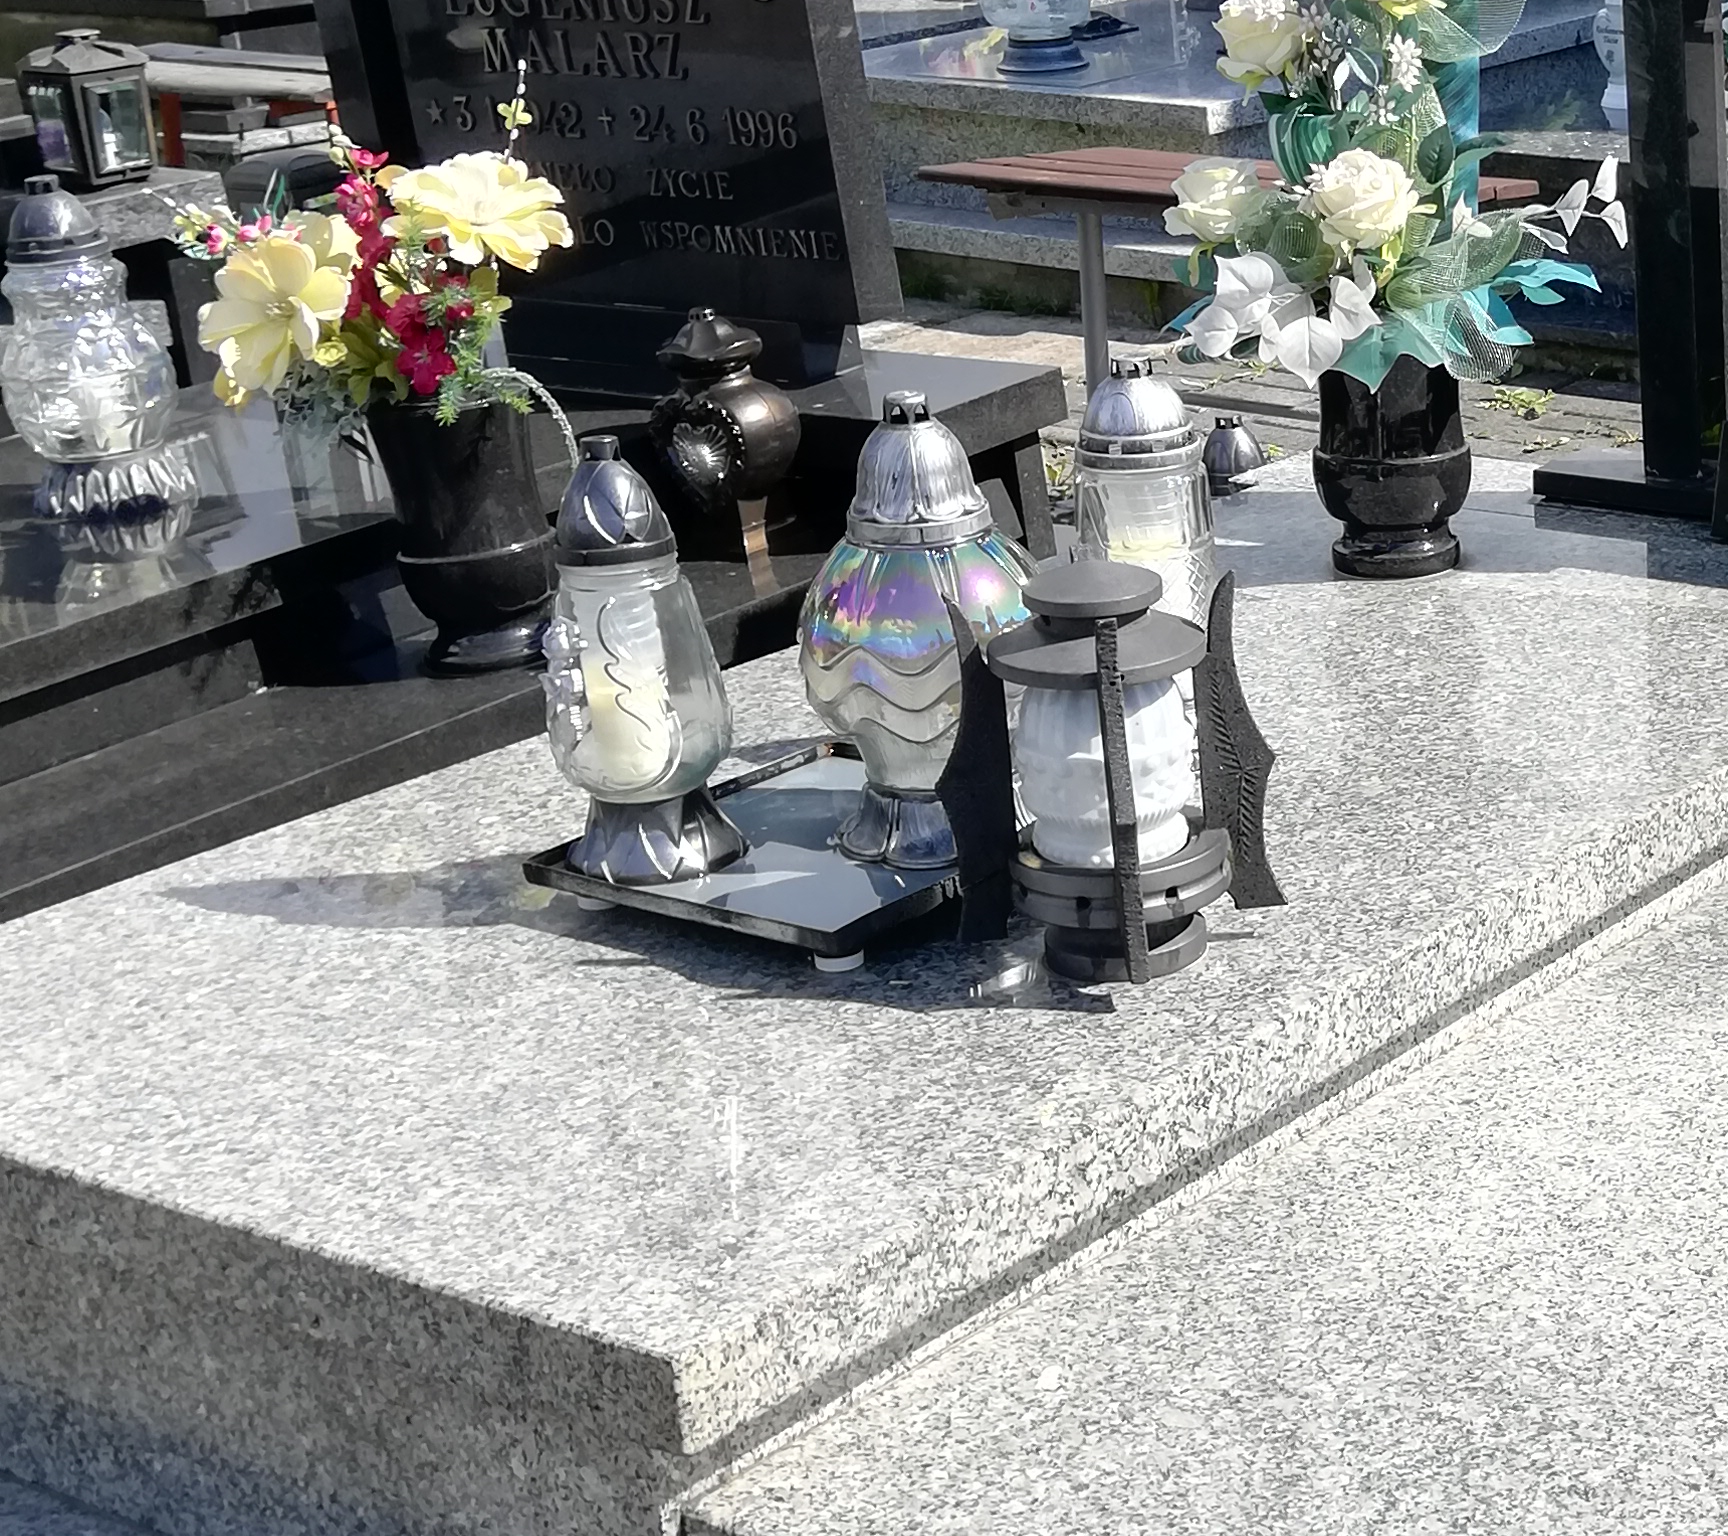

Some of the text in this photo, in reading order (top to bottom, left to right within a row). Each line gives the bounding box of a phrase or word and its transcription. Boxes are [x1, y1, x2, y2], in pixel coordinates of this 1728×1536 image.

[480, 27, 690, 81] MALARZ
[722, 105, 799, 150] 1996
[638, 219, 845, 263] WSPOMNIENIE
